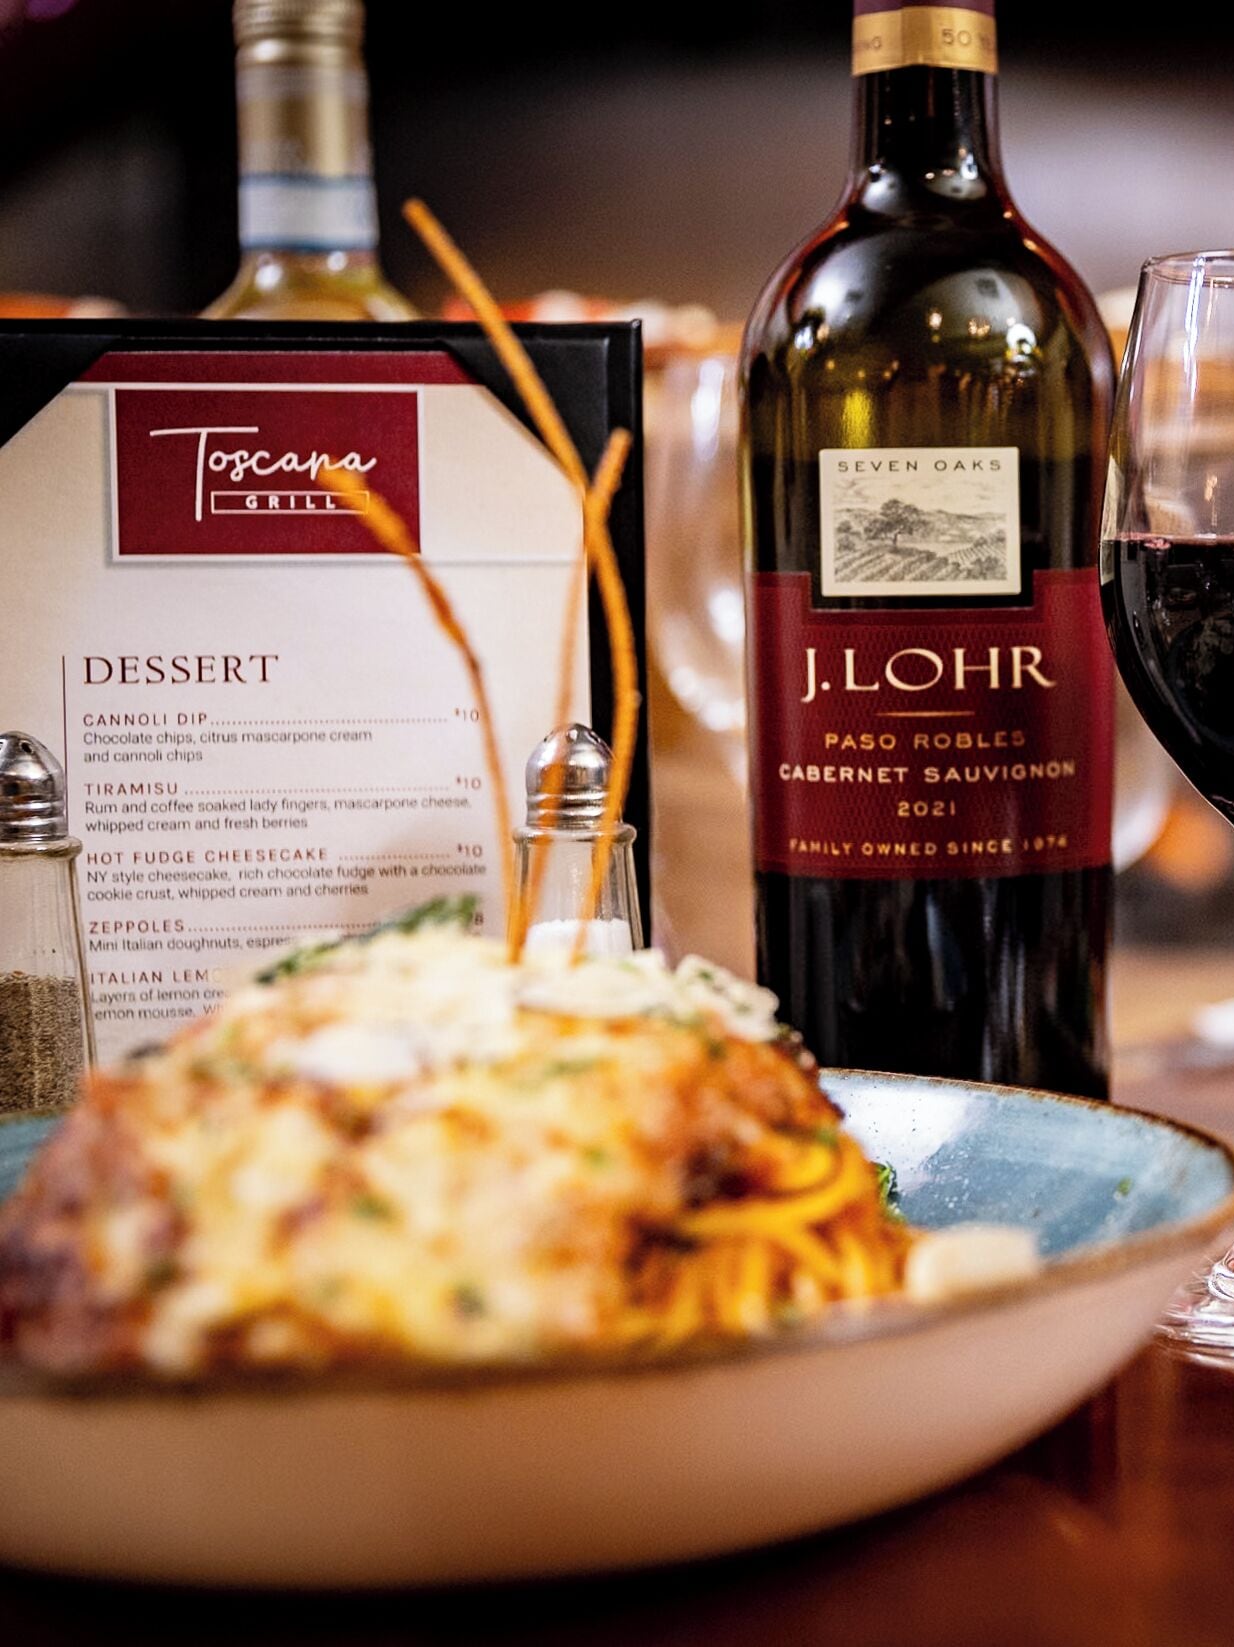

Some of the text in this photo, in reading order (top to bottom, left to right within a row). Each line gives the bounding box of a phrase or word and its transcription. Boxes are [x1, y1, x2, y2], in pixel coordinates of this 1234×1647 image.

[942, 28, 971, 46] 50
[837, 458, 1003, 473] SEVEN OAKS
[149, 426, 378, 523] Toscana
[245, 494, 337, 511] GRILL
[83, 653, 280, 685] DESSERT
[83, 713, 167, 727] CANNOLI
[177, 712, 208, 726] DIP
[83, 730, 373, 746] Chocolate chips, citrus mascarpone cream
[825, 731, 1026, 750] PASO ROBLES
[84, 749, 203, 764] and cannoli chips
[779, 760, 1076, 783] CABERNET SAUVIGNON
[84, 782, 178, 796] TIRAMISU
[85, 800, 117, 814] Rum
[121, 800, 147, 814] and
[150, 799, 194, 813] coffee
[198, 799, 246, 812] soaked
[249, 798, 276, 816] lady
[334, 797, 418, 811] mascarpone
[897, 801, 957, 817] 2021
[85, 816, 308, 834] whipped cream and fresh berries
[789, 838, 854, 855] FAMILY
[861, 842, 937, 857] OWNED
[947, 839, 1013, 855] SINCE
[87, 852, 124, 865] HOT
[133, 850, 196, 864] FUDGE
[204, 848, 328, 863] CHEESECAKE
[87, 870, 108, 883] NY
[112, 870, 144, 886] style
[239, 868, 263, 880] rich
[267, 866, 333, 880] chocolate
[337, 865, 375, 880] fudge
[378, 864, 406, 877] with
[410, 866, 418, 876] a
[421, 863, 486, 877] chocolate
[87, 883, 369, 902] cookie crust, whipped cream and cherries
[89, 918, 185, 934] ZEPPOLES
[89, 939, 118, 952] Mini
[122, 938, 163, 951] Italian
[91, 970, 163, 985] ITALIAN
[91, 990, 136, 1006] Layers
[140, 989, 154, 1001] of
[157, 988, 200, 1001] lemon
[95, 1007, 135, 1021] emon
